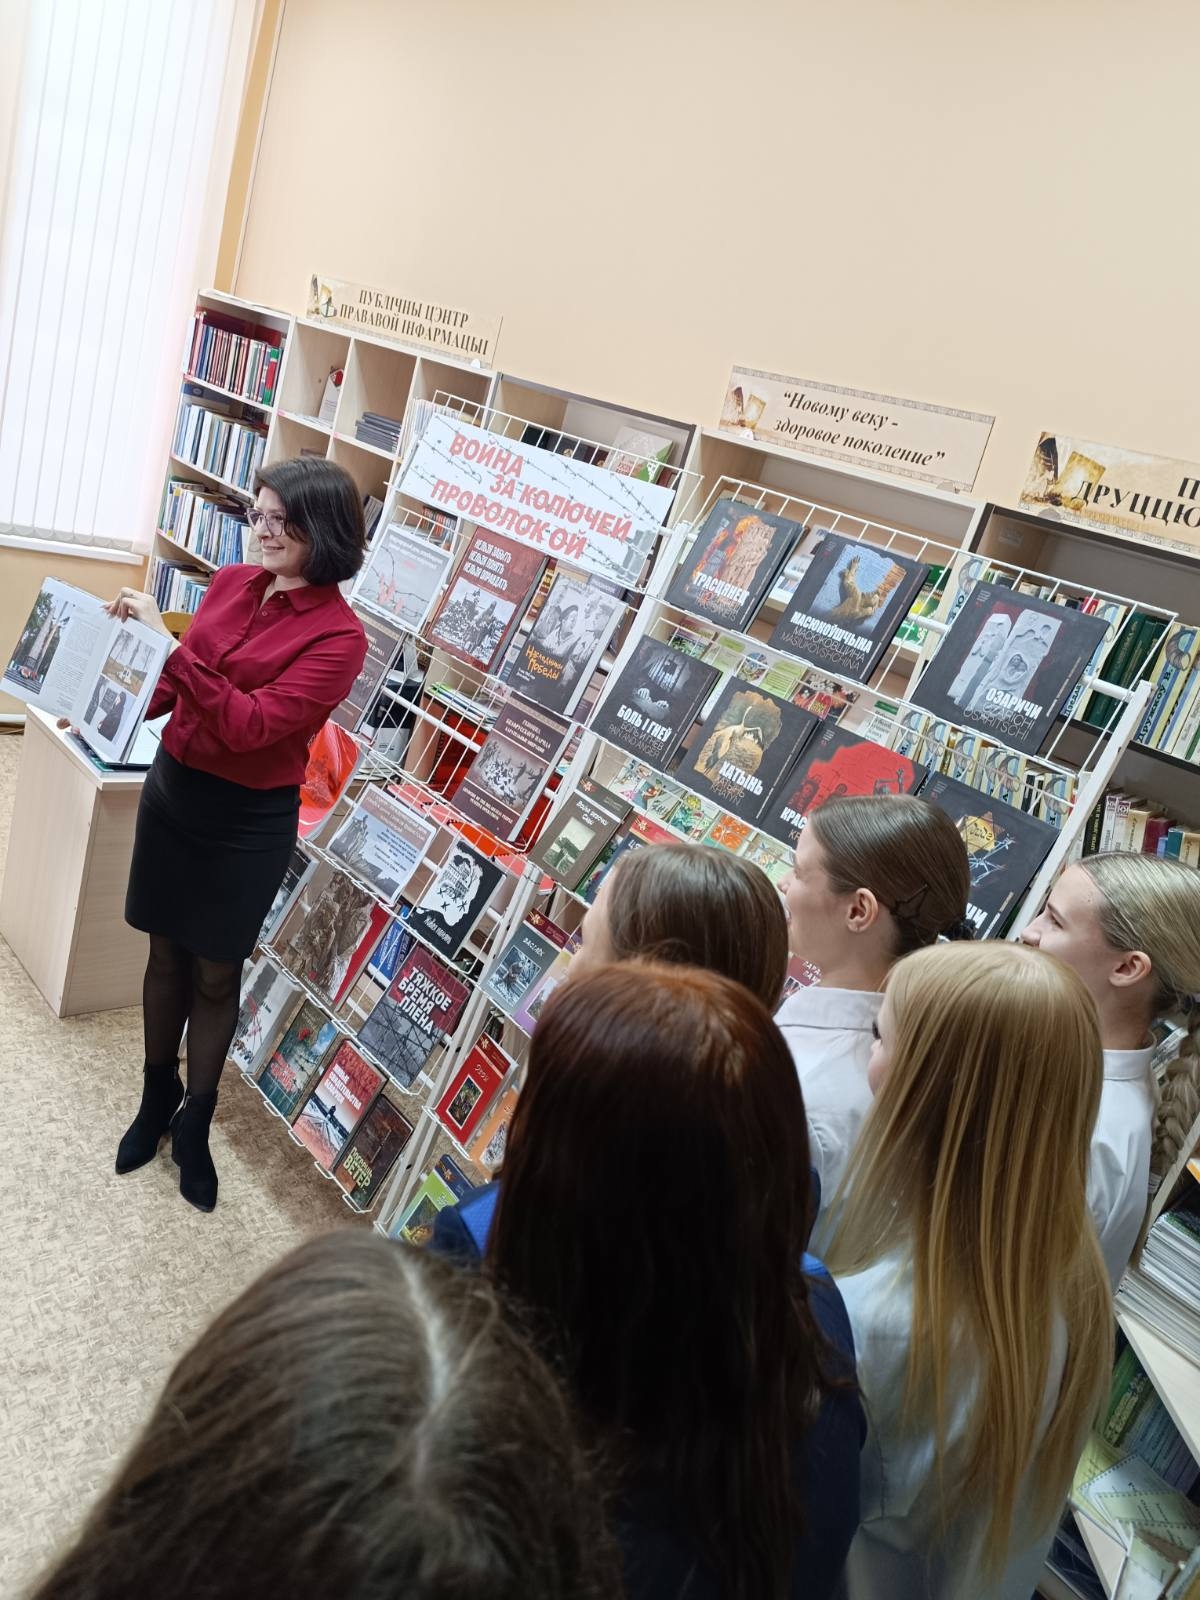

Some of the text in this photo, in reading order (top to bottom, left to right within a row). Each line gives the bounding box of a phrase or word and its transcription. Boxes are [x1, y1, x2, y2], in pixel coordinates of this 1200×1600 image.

[359, 289, 469, 328] ПУБЛІЧНЫ ЦЭНТР
[340, 303, 489, 355] ПРАВАВОЙ ІНФАРМАЦЫІ
[773, 417, 841, 446] здоровое
[851, 409, 889, 432] веку
[449, 432, 524, 478] ВОЙНА
[489, 474, 518, 500] ЗА
[519, 486, 633, 543] КОЛЮЧЕЙ
[790, 611, 873, 653] МАСЮКОЎШЧЫНА
[985, 687, 1043, 720] ОЗАРИЧИ
[617, 704, 643, 728] БОЛЬ
[646, 721, 673, 743] ГНЕЎ
[719, 761, 763, 796] ХАТЫНЬ
[780, 806, 808, 830] КРАС
[398, 976, 435, 1015] БРЕМЯ
[409, 966, 452, 1012] ТЯЖКОЕ
[399, 995, 434, 1035] ПЛЕНА
